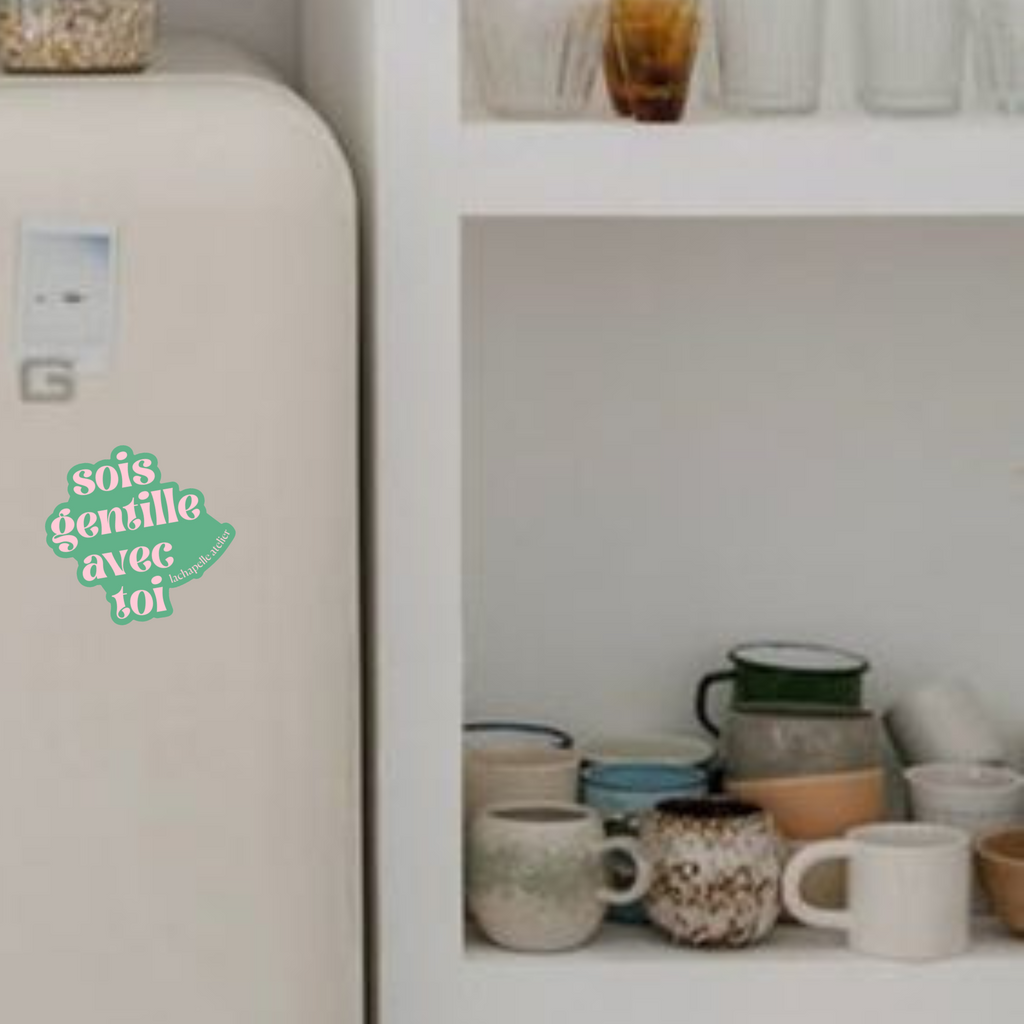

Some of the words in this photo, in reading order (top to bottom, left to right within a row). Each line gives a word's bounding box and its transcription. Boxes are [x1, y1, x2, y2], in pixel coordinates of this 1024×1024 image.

[72, 451, 156, 496] sois
[50, 487, 201, 553] gentille
[82, 541, 175, 582] avec
[169, 555, 211, 583] lachapelle
[210, 529, 230, 556] atelier
[111, 575, 168, 620] toi
